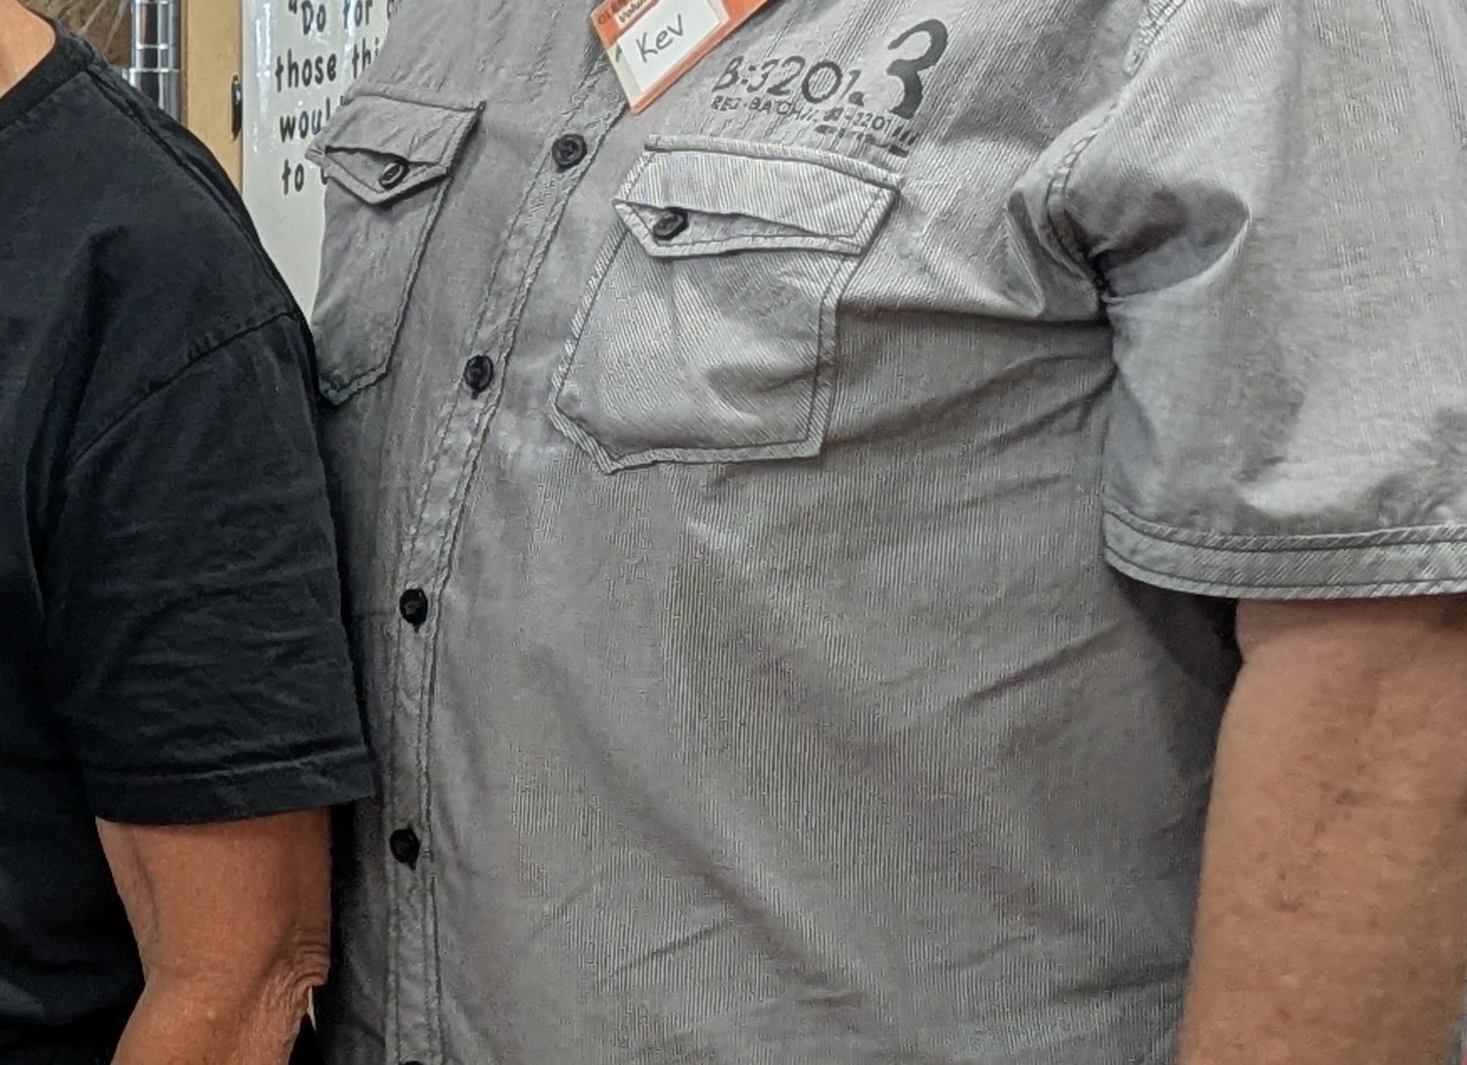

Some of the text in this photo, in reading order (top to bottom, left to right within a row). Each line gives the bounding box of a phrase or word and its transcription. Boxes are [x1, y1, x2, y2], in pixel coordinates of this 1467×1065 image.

[635, 13, 684, 63] Kev
[275, 48, 337, 93] those
[282, 158, 304, 195] to
